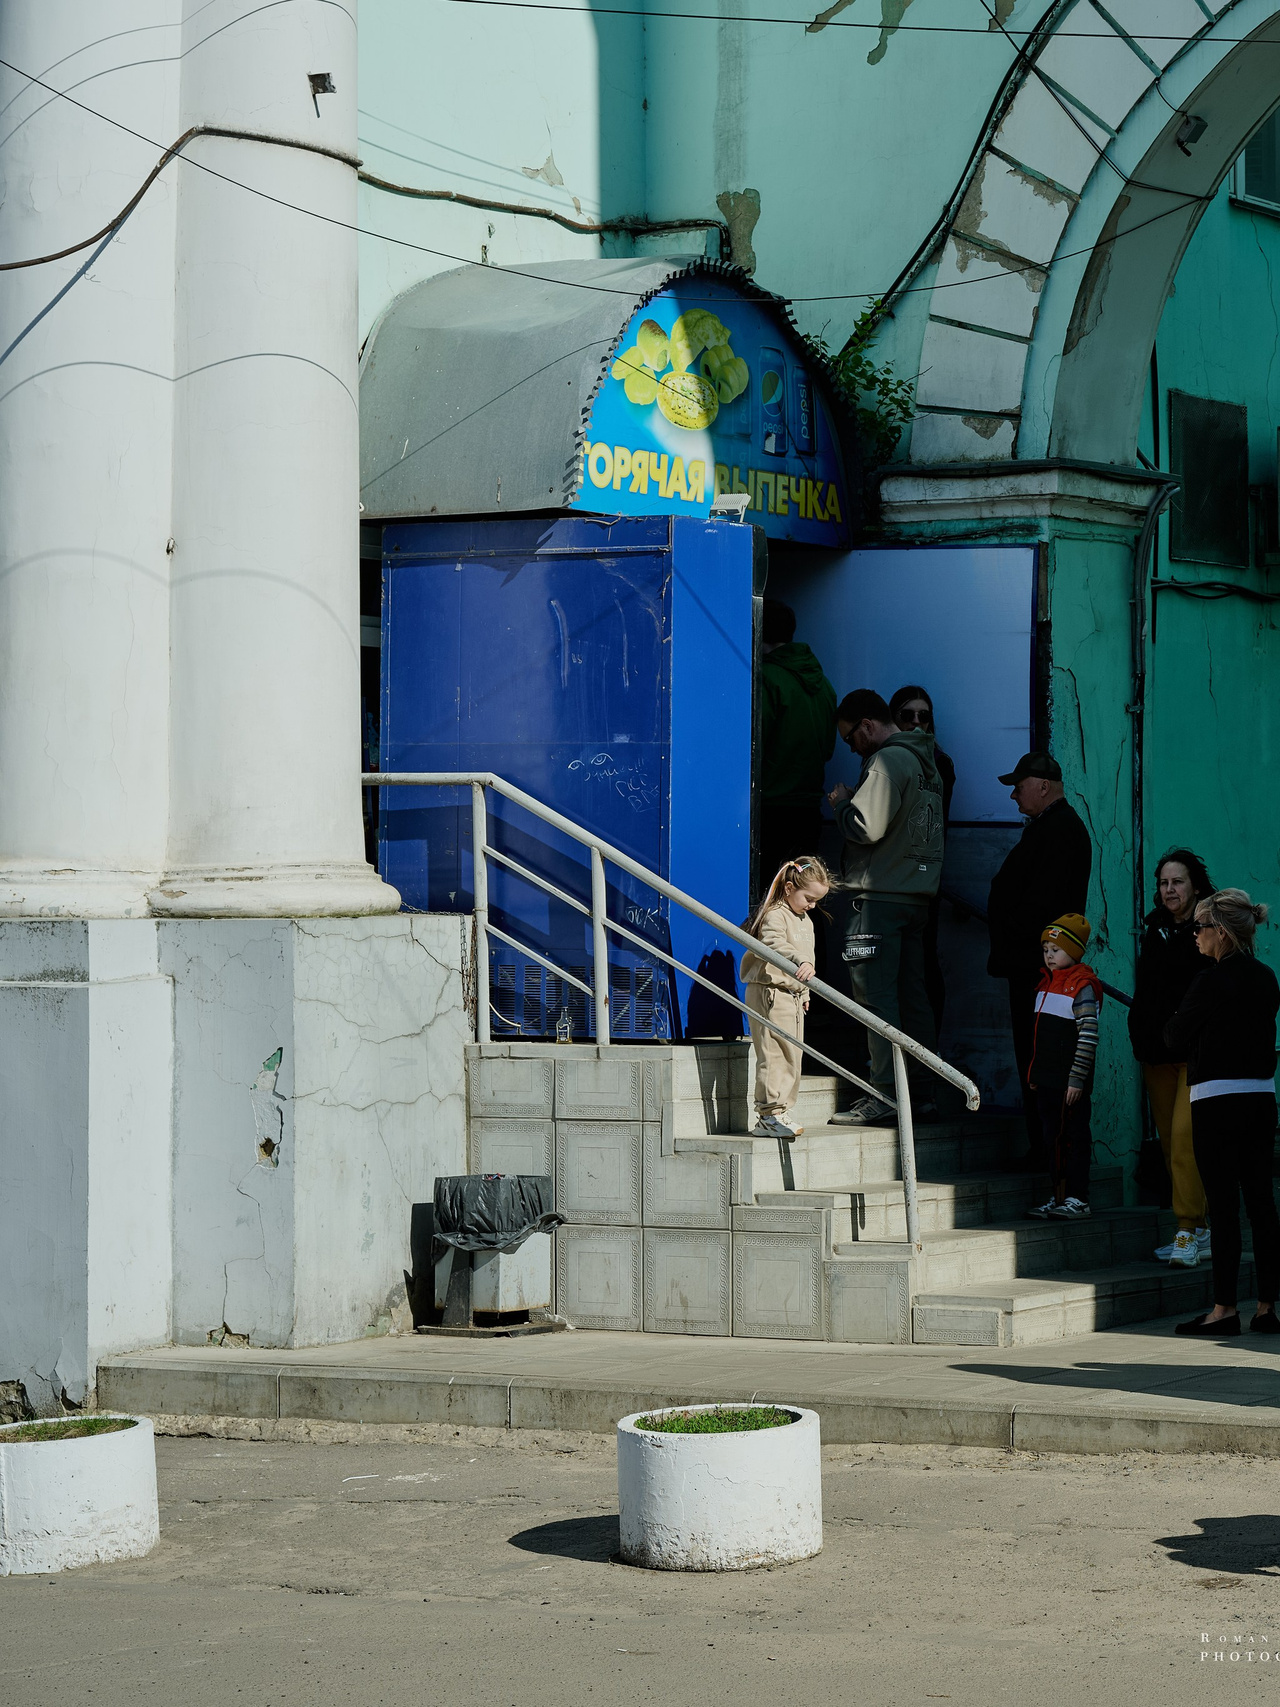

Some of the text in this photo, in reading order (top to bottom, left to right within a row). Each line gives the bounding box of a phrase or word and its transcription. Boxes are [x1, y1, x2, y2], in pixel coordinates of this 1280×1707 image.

[762, 420, 784, 434] pepsi
[798, 383, 811, 439] pepsi
[577, 440, 843, 524] ГОРЯЧАЯ ВЫПЕЧКА
